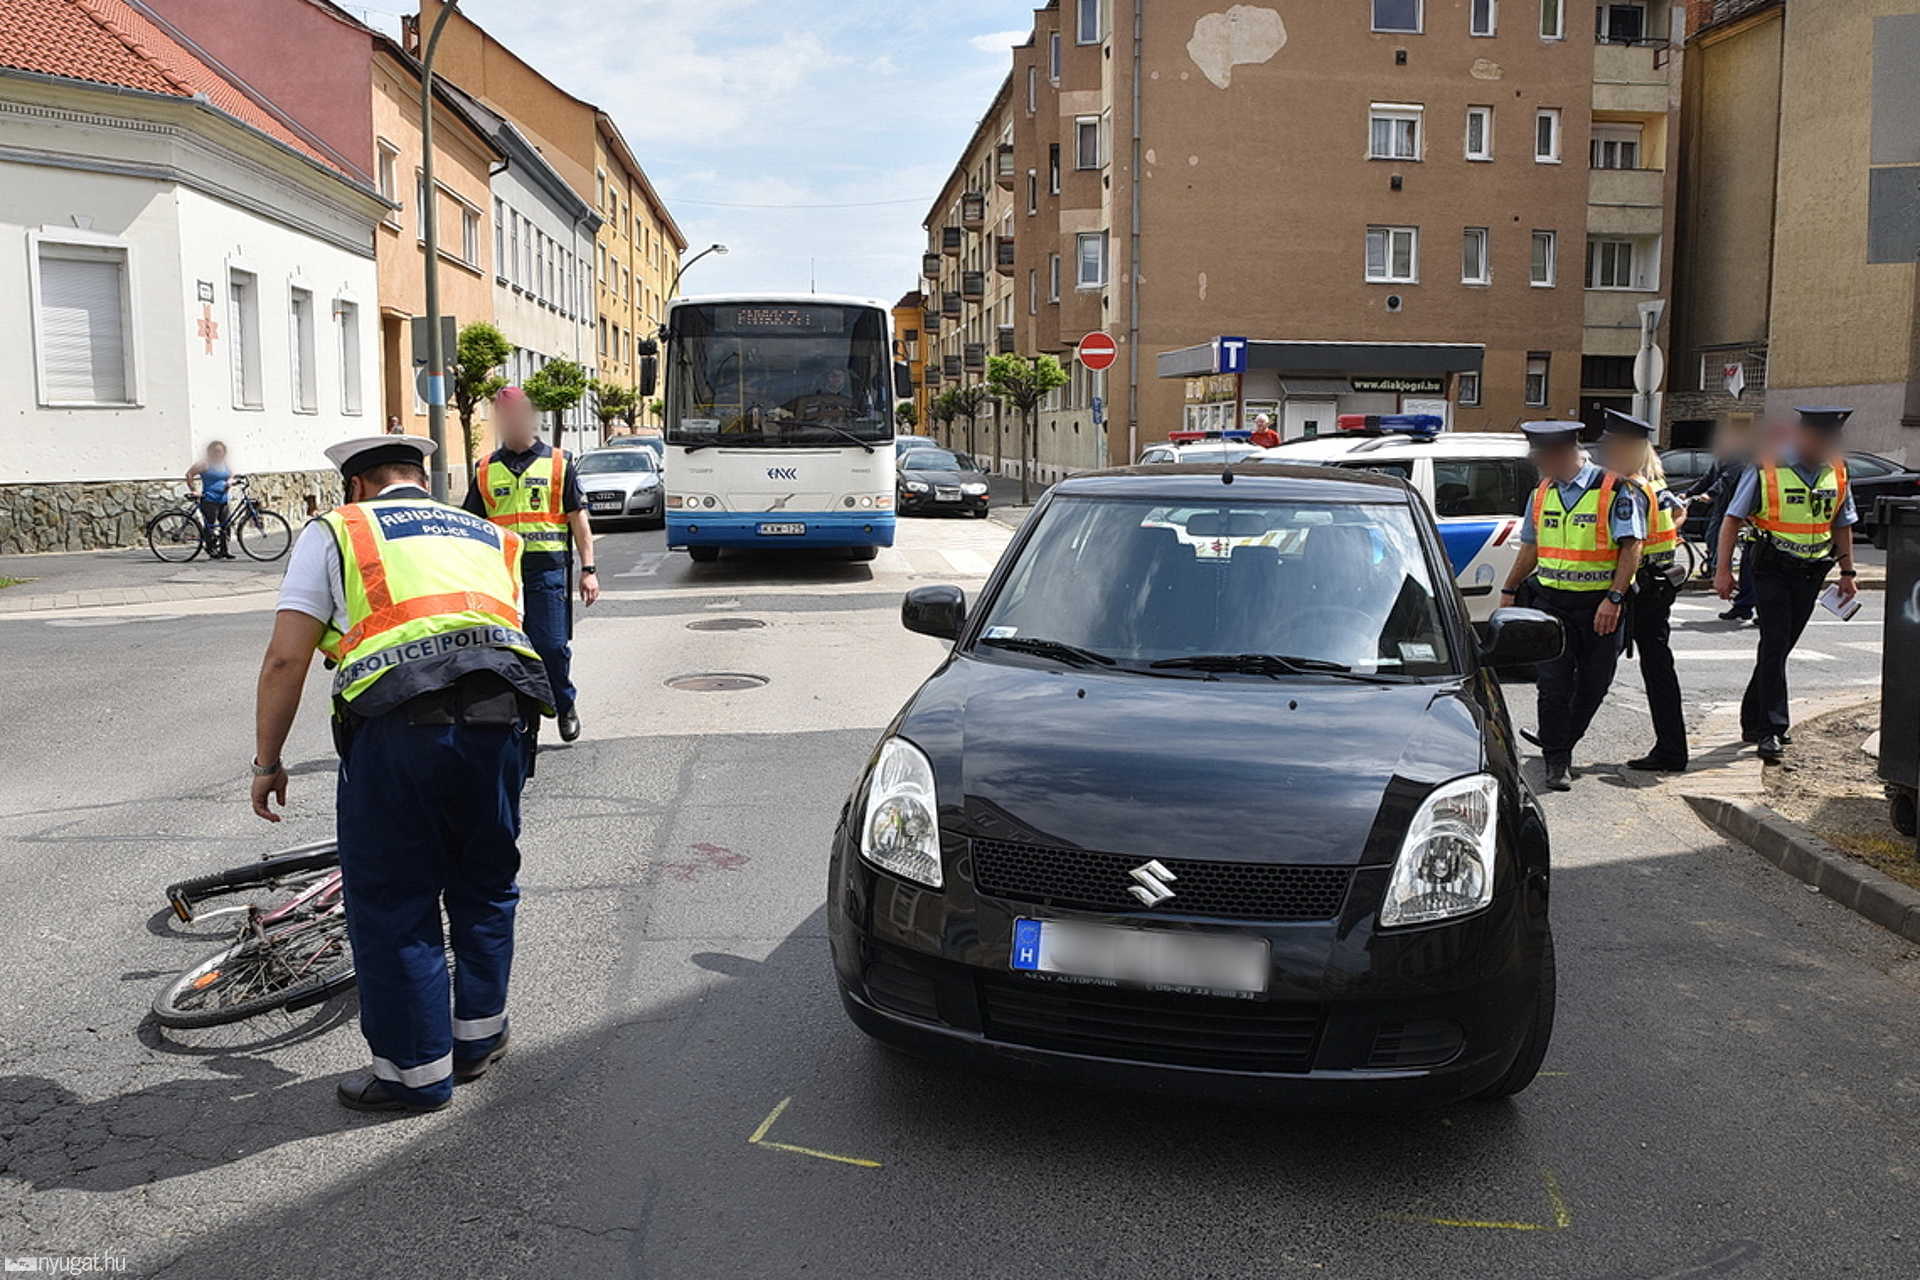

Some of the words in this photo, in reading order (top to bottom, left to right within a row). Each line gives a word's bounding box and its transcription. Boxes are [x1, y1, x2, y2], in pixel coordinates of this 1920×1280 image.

[1223, 341, 1244, 369] T
[422, 525, 471, 537] POLICE
[351, 641, 433, 678] POLICE
[1019, 948, 1033, 963] H
